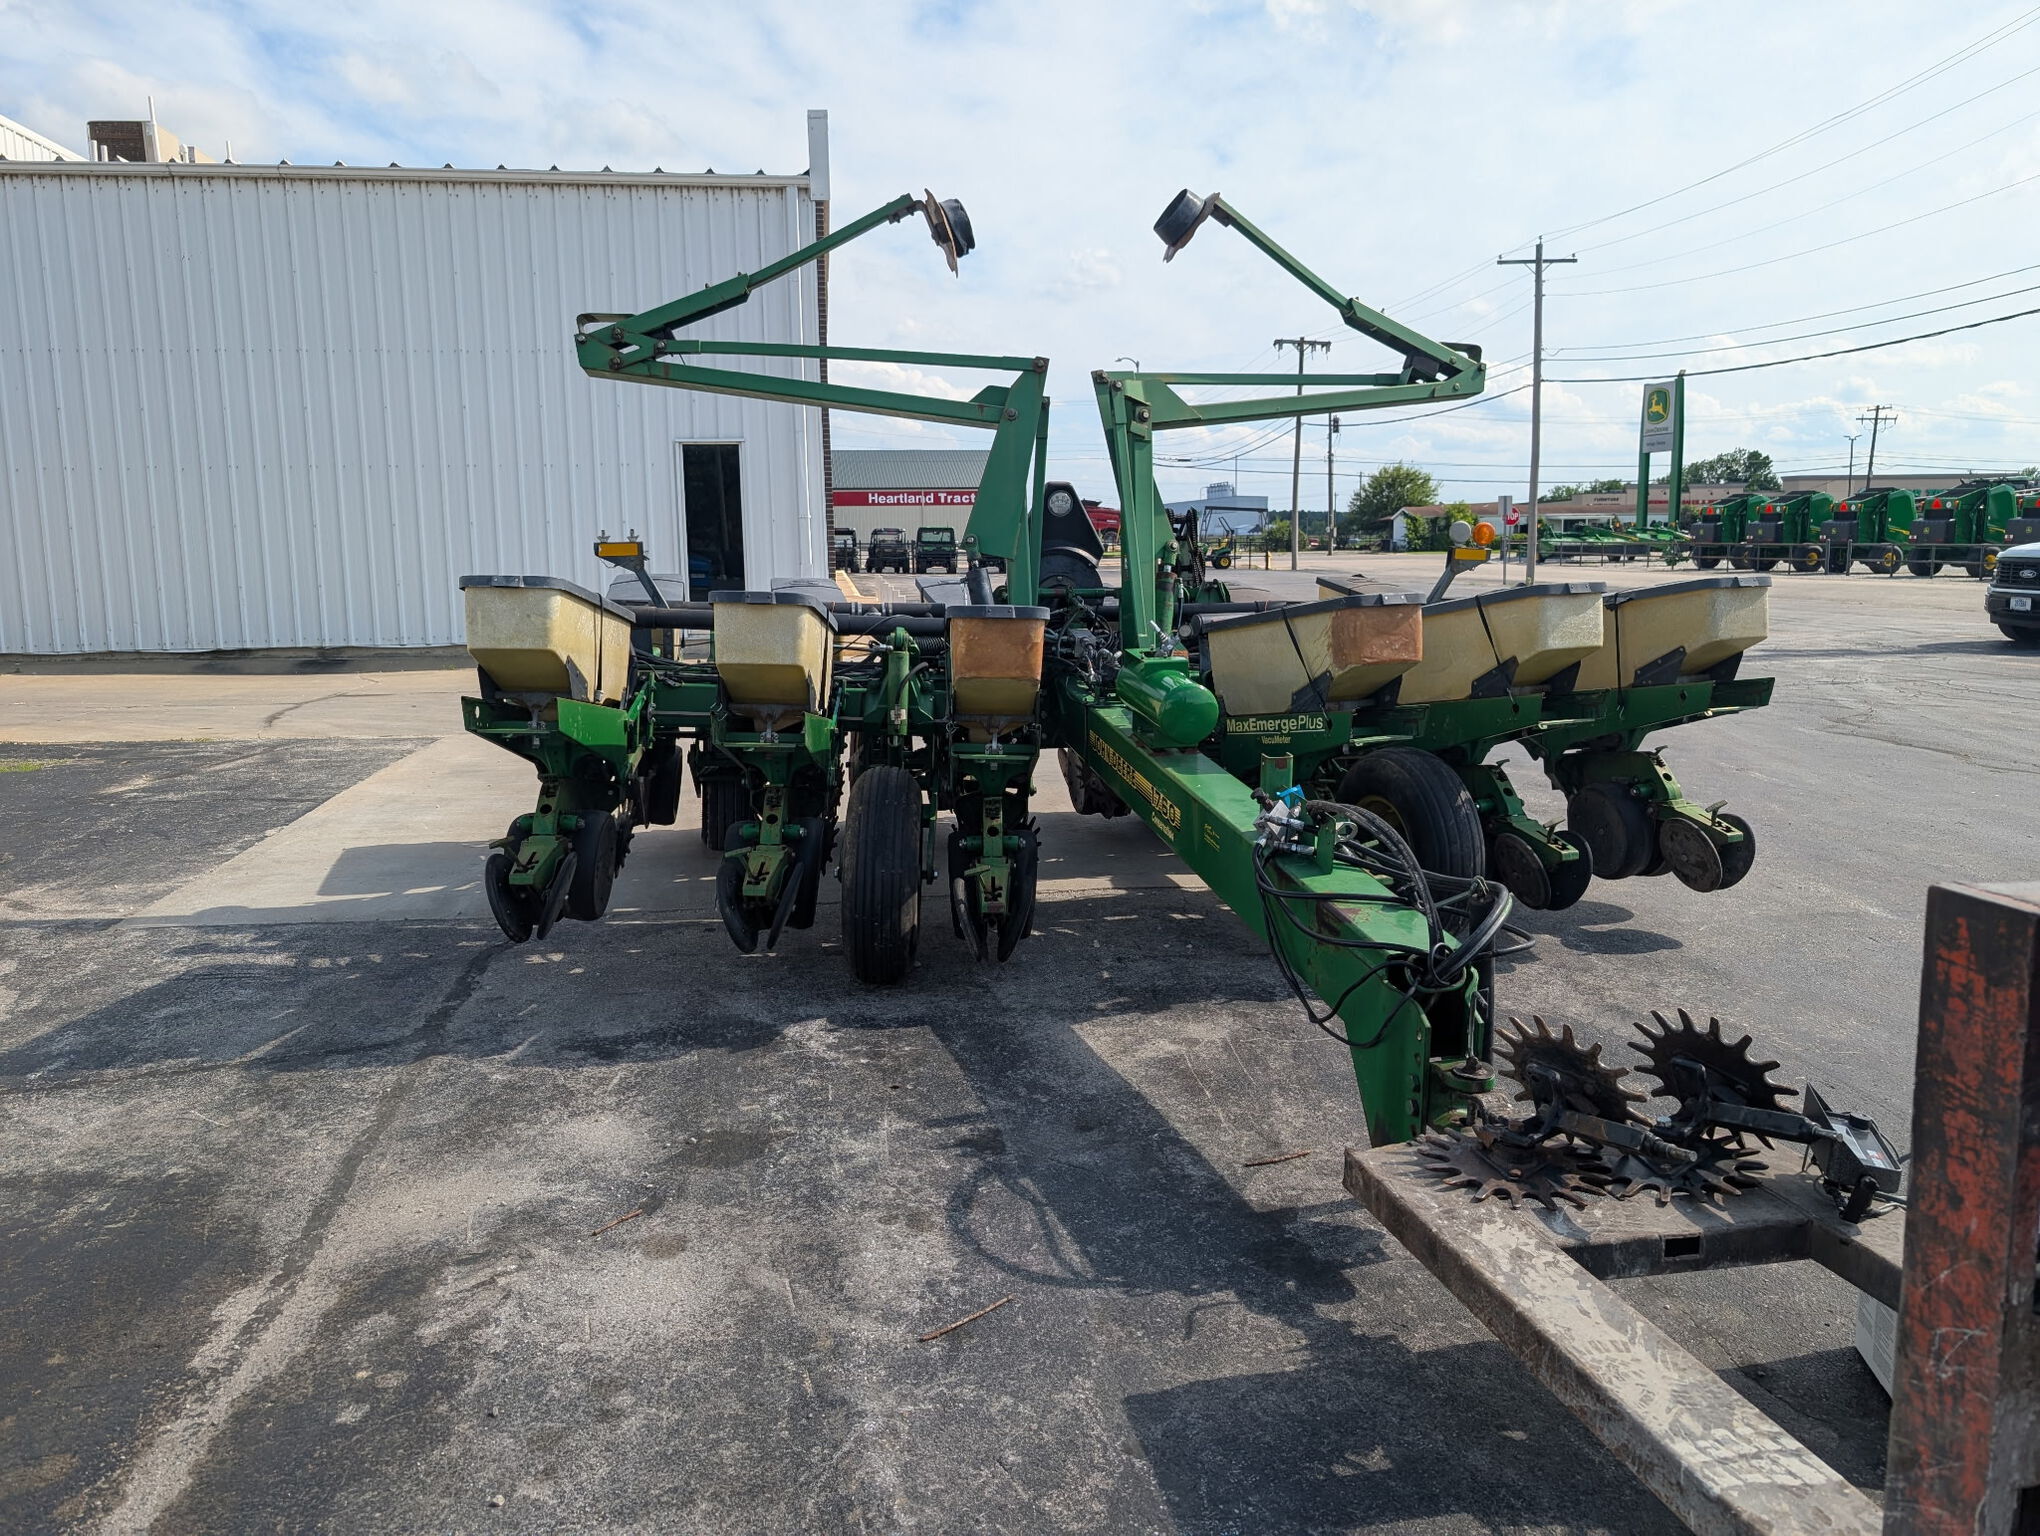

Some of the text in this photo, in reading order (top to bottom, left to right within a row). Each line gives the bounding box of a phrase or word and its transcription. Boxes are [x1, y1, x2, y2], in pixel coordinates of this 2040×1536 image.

[868, 492, 976, 504] Heartland Tract
[1261, 736, 1292, 744] VacuMeter
